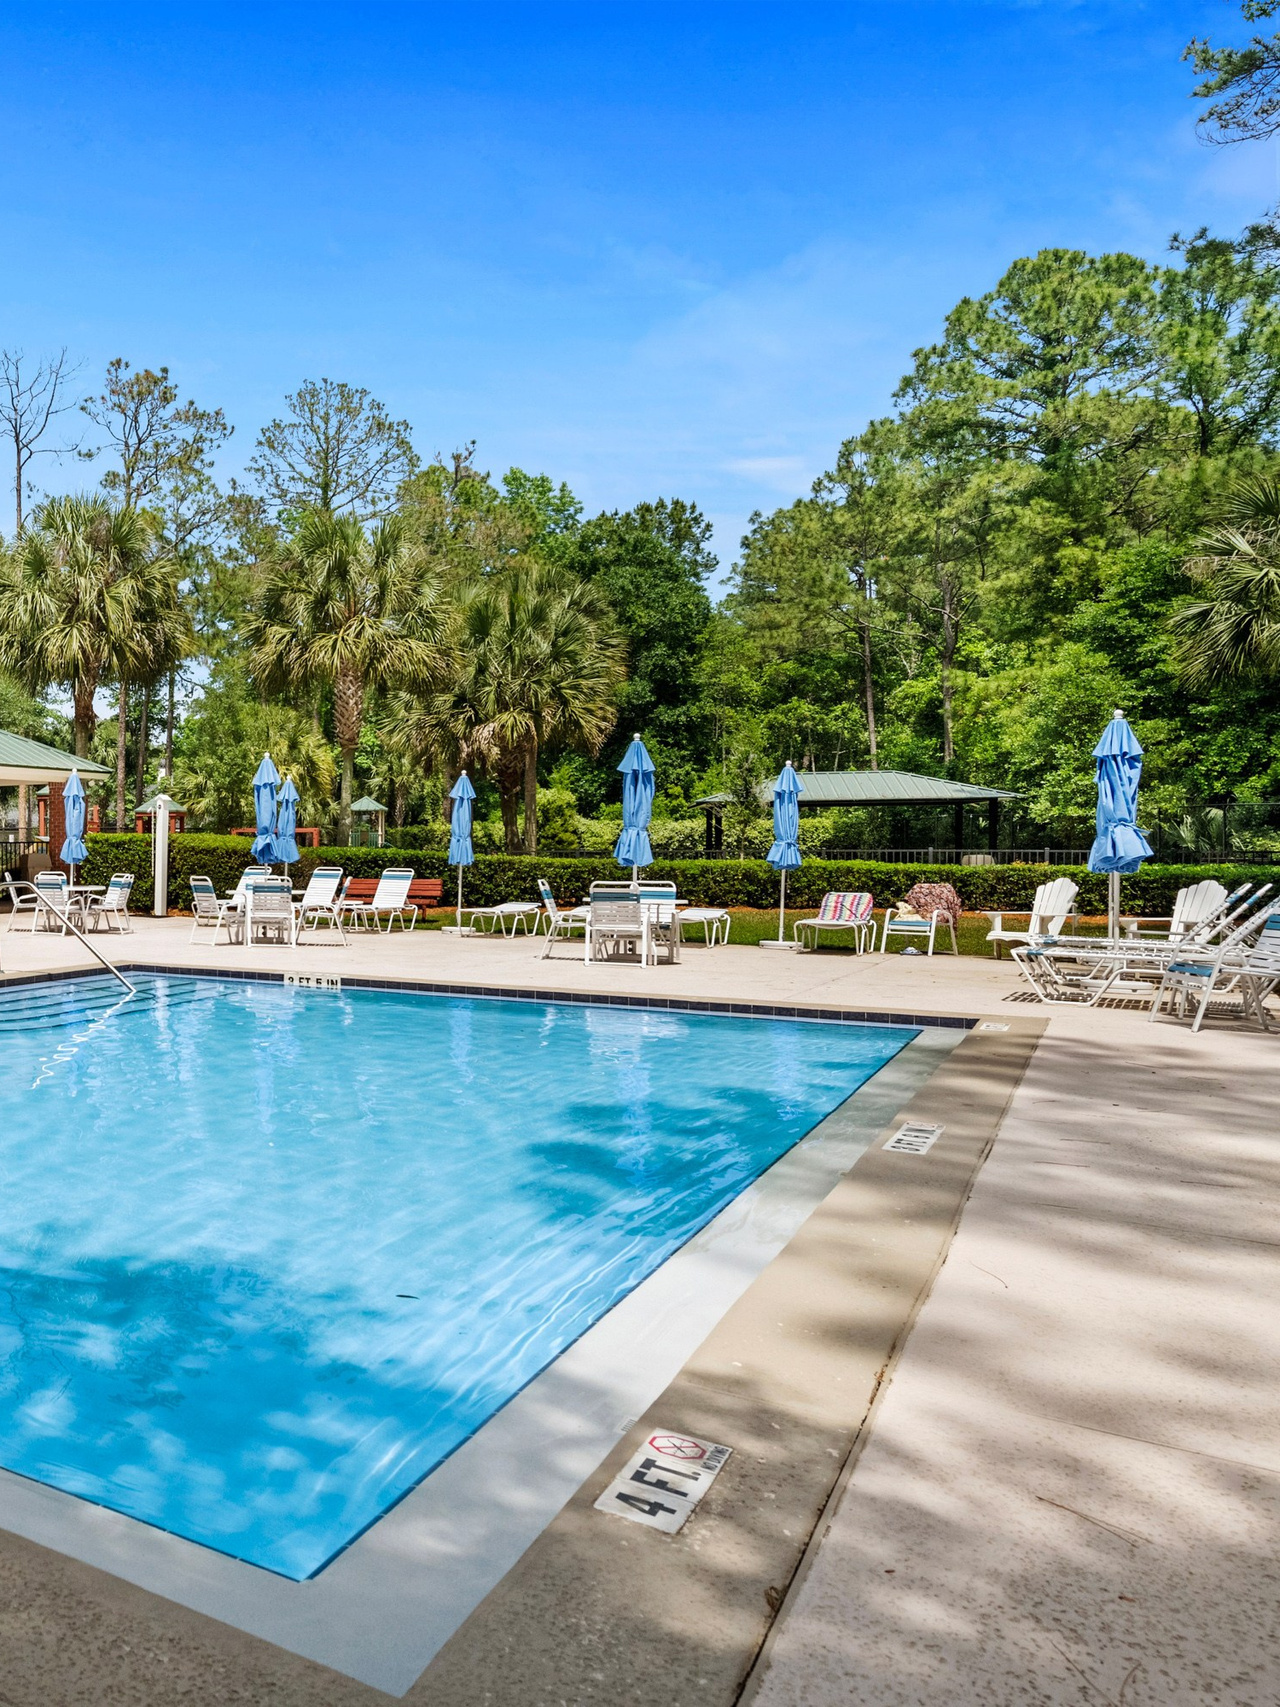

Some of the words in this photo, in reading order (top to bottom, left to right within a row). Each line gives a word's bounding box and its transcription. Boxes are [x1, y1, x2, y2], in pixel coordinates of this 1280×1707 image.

[299, 976, 311, 984] FT
[327, 978, 338, 986] IN
[706, 1445, 730, 1464] DIVING
[700, 1460, 719, 1472] NO
[630, 1457, 702, 1498] FT.
[615, 1491, 677, 1517] 4
